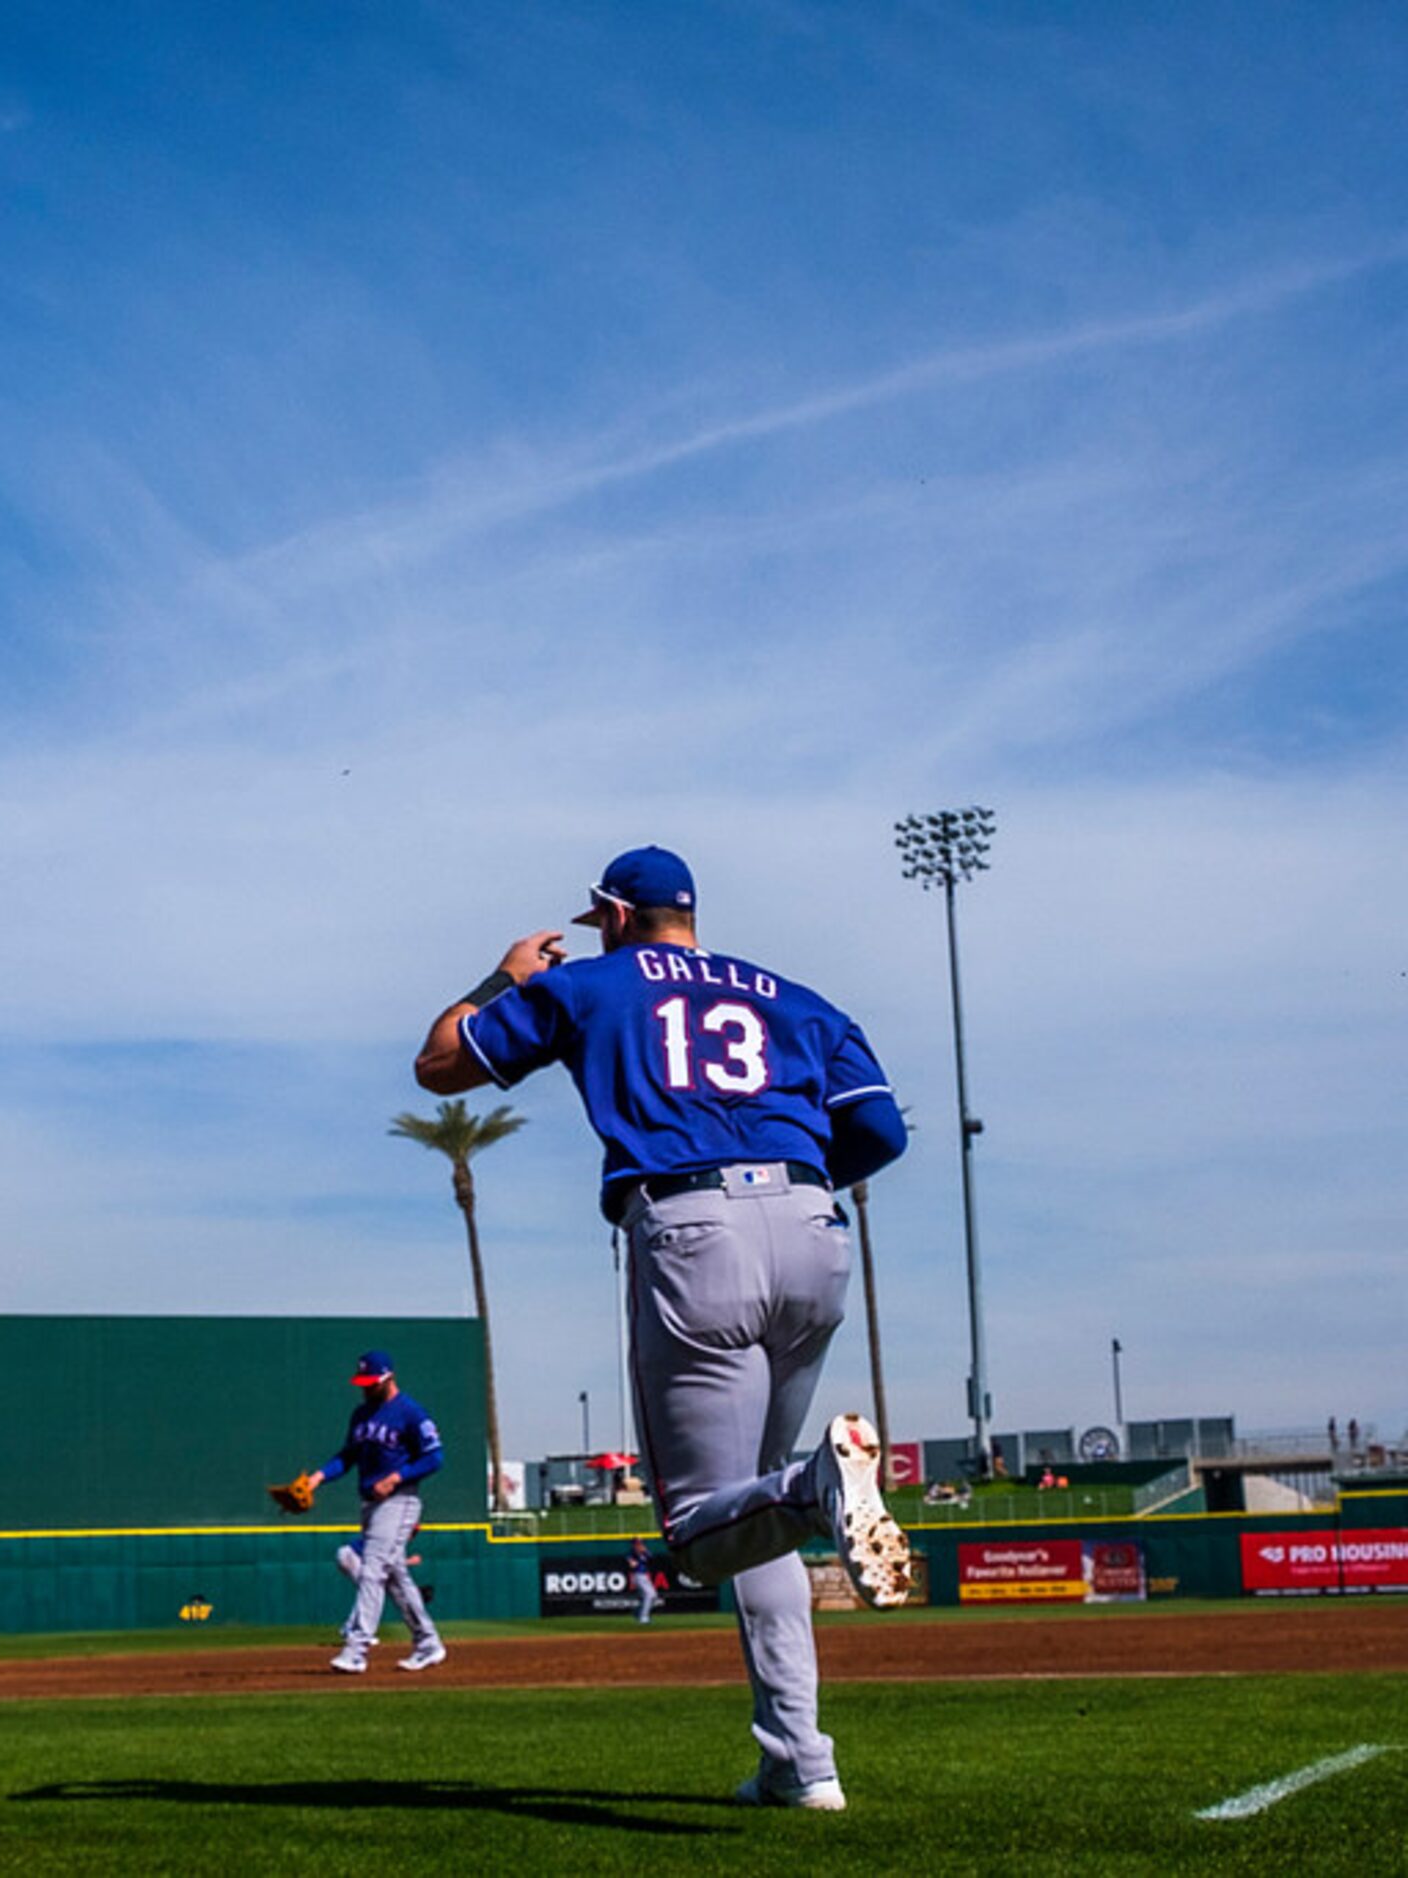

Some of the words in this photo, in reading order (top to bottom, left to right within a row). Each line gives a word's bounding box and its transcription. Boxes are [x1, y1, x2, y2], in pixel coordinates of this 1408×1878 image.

[636, 948, 778, 999] GALLO
[654, 996, 770, 1095] 13
[1289, 1545, 1328, 1563] PRO
[545, 1571, 627, 1594] RODEO
